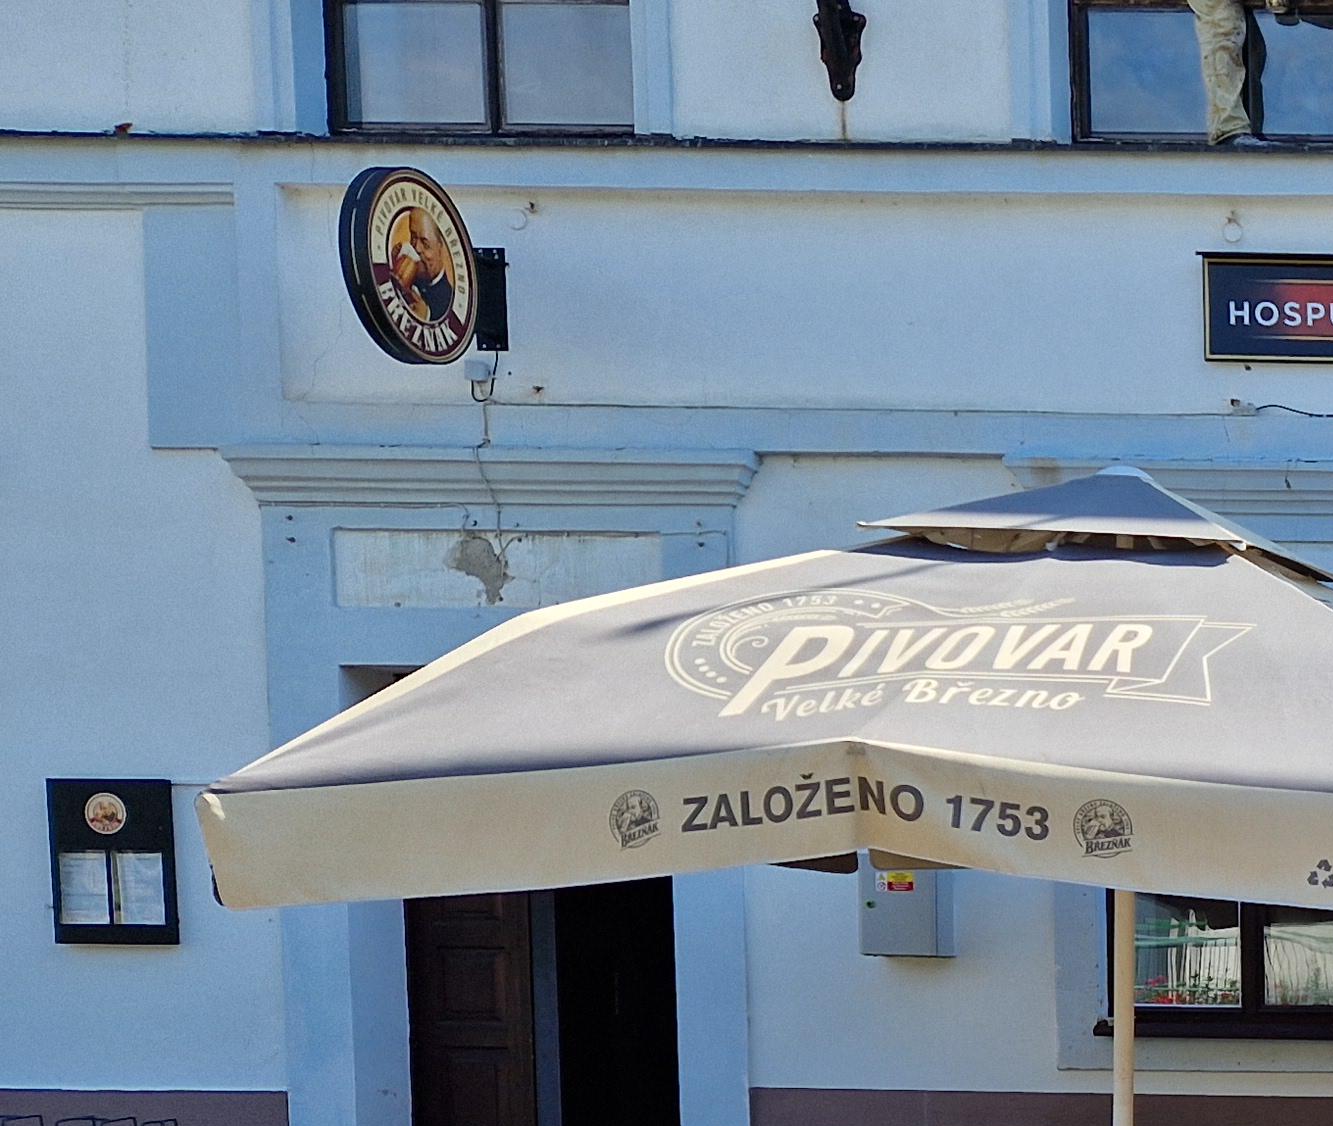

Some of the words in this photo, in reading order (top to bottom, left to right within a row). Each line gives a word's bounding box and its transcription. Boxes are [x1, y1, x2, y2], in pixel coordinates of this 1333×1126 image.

[375, 187, 407, 236] PIVOVAR
[718, 623, 1153, 718] PIVOVAR
[761, 683, 886, 721] Velké
[902, 678, 1086, 710] Březno
[681, 773, 925, 832] ZALOŽENO
[945, 794, 1050, 841] 1753
